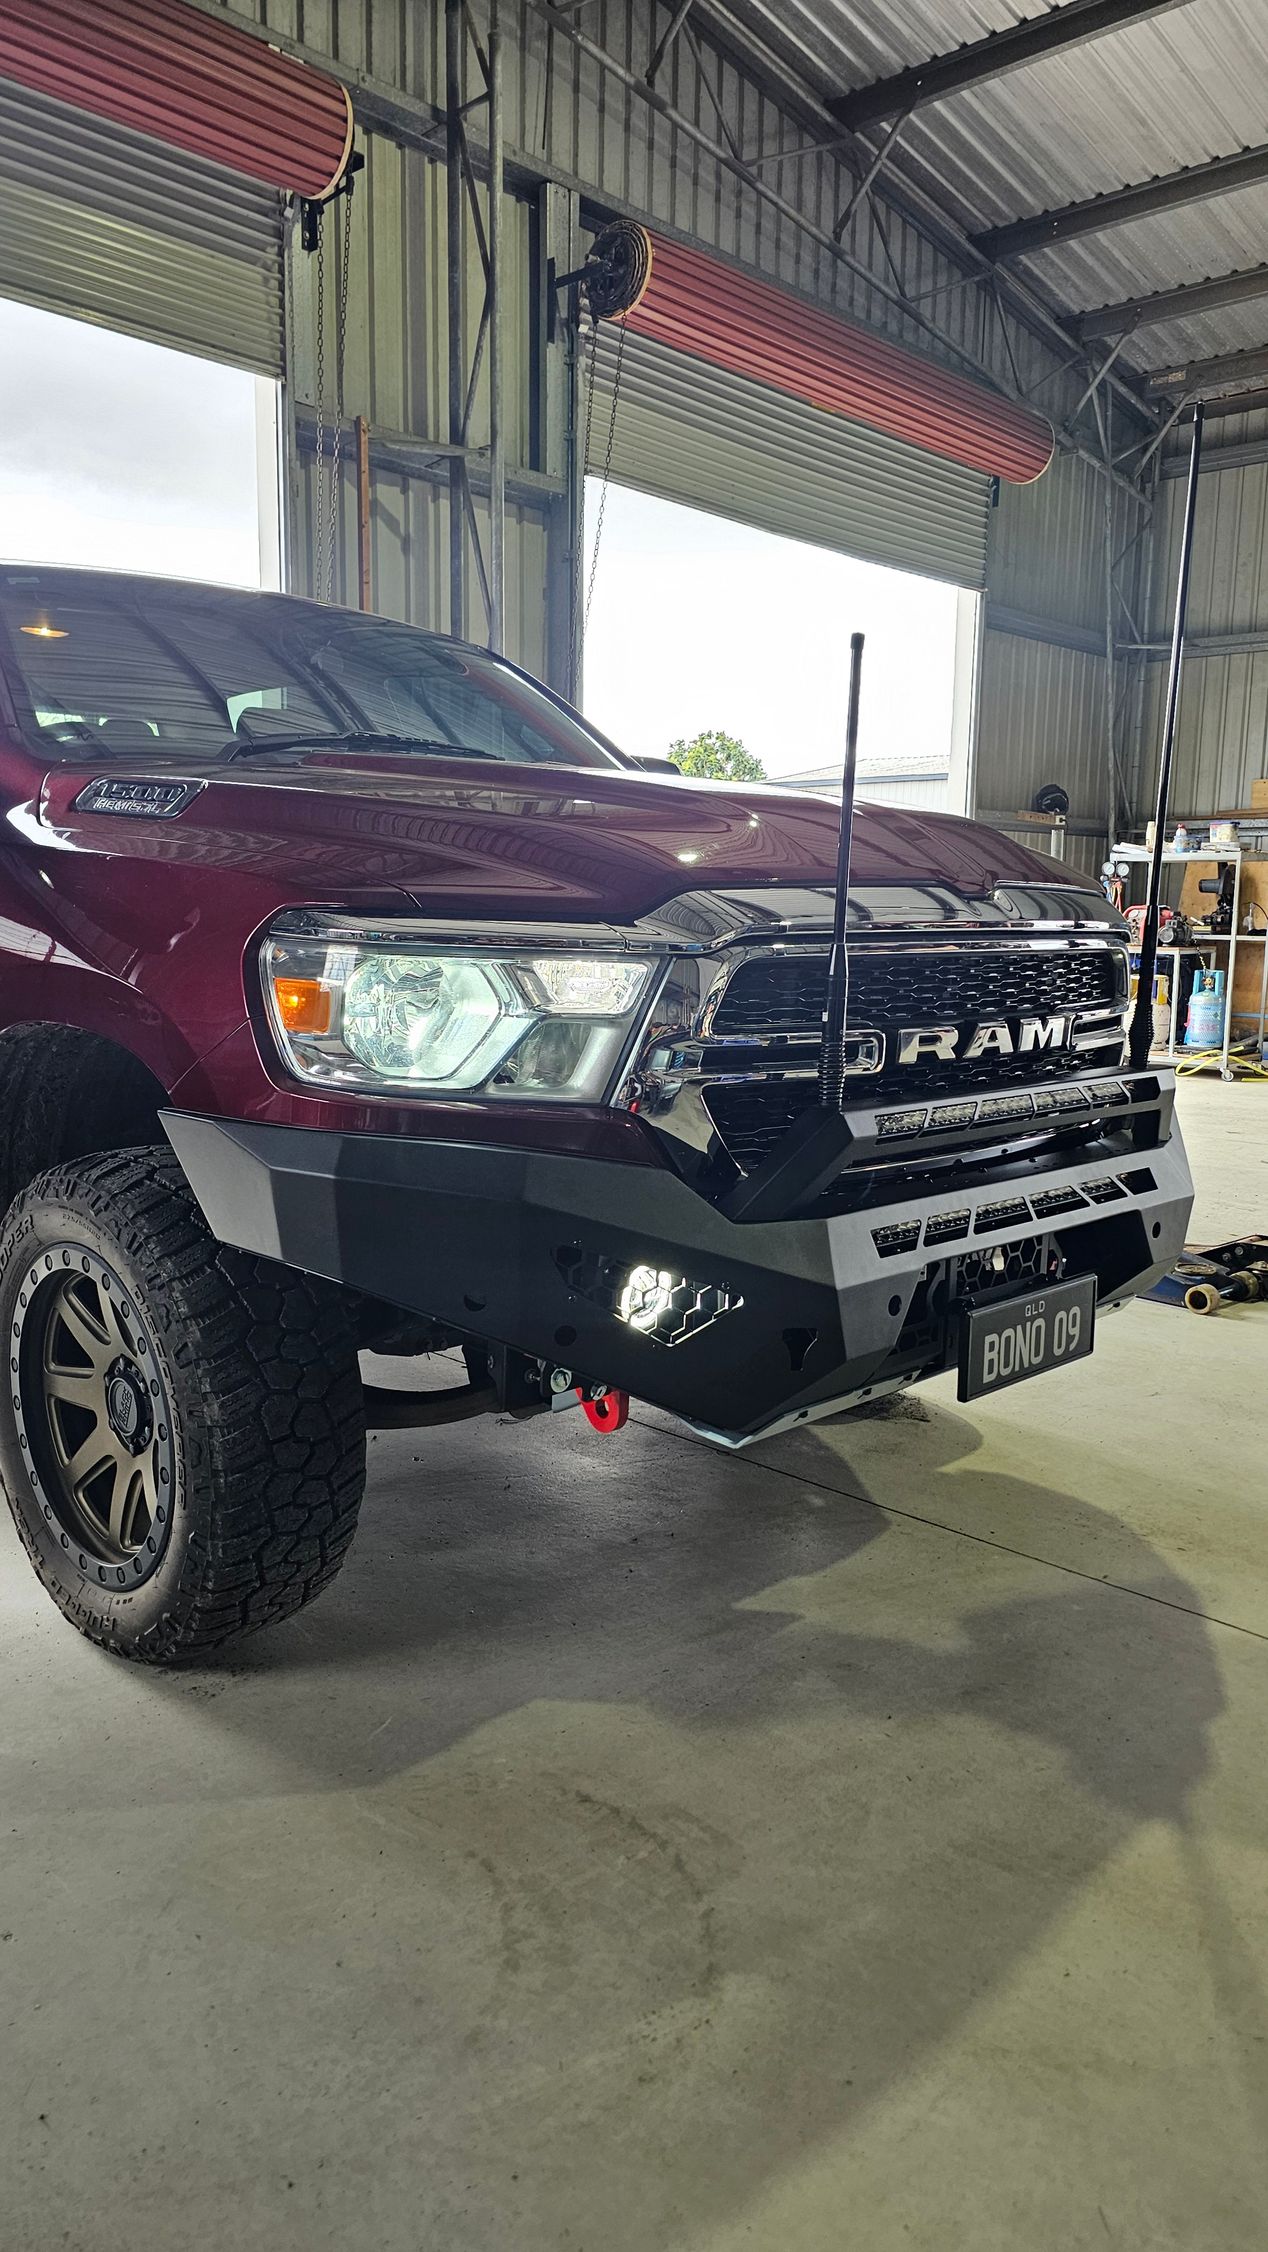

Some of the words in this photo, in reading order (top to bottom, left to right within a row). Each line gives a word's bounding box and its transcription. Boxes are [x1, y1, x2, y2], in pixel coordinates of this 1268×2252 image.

[97, 783, 183, 802] 1500
[898, 1016, 1066, 1064] RAM
[1025, 1300, 1046, 1317] QLD
[983, 1317, 1046, 1384] BONO
[1053, 1305, 1081, 1357] 09
